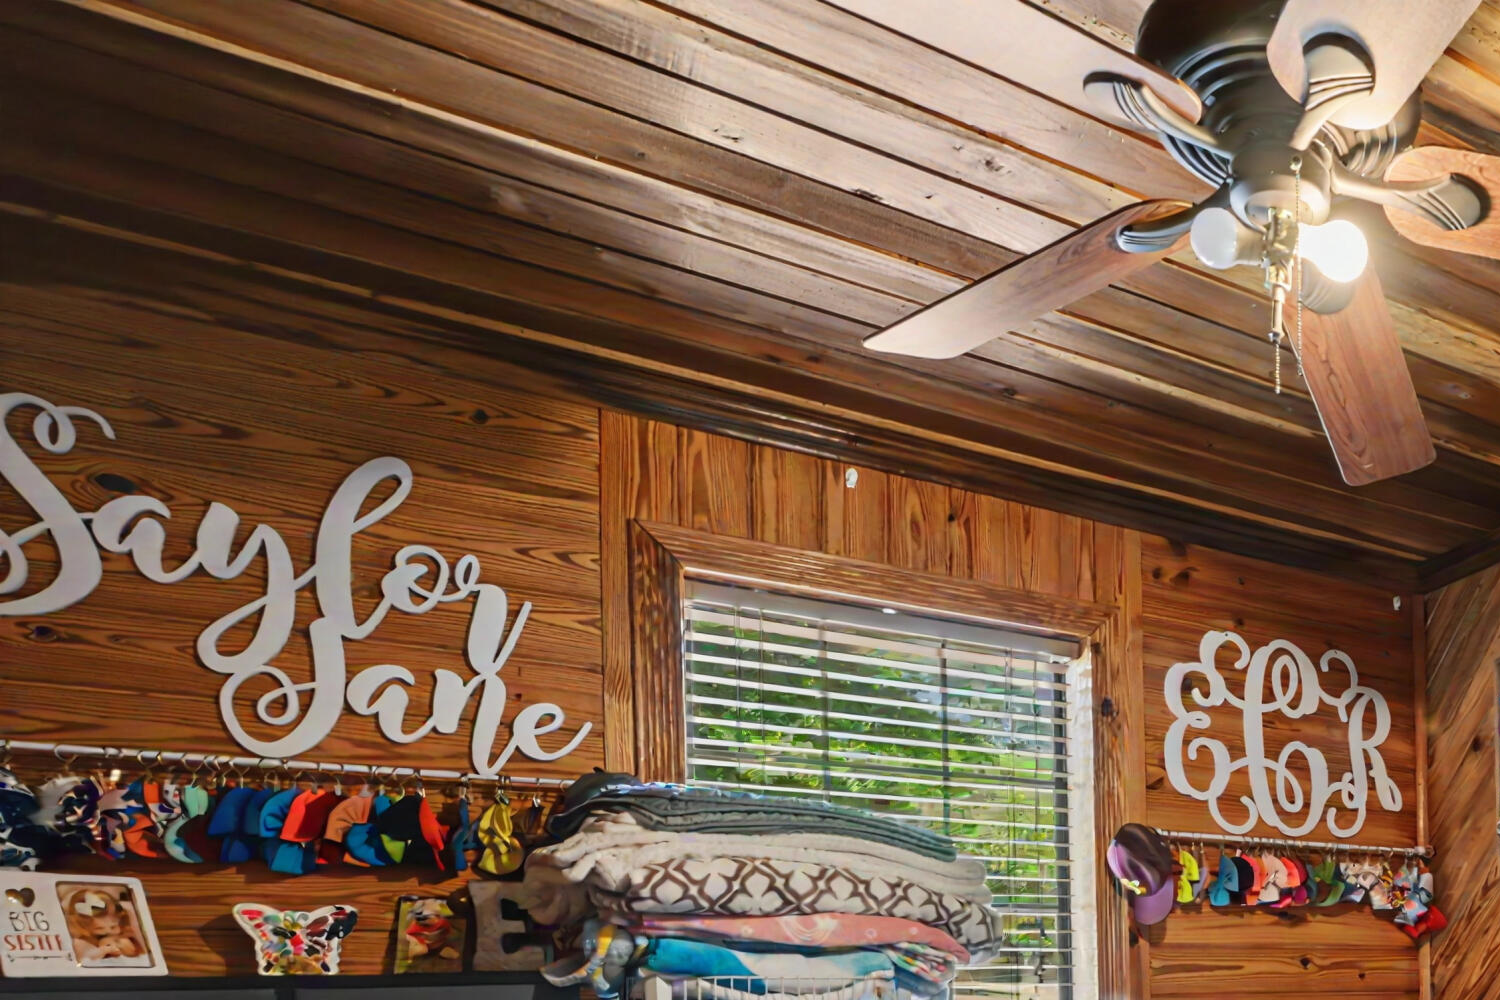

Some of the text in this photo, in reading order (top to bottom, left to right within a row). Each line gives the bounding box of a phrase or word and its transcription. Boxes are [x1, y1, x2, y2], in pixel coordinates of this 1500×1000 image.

[0, 393, 532, 675] Saylor
[219, 616, 593, 777] Jane
[9, 911, 50, 932] BIG
